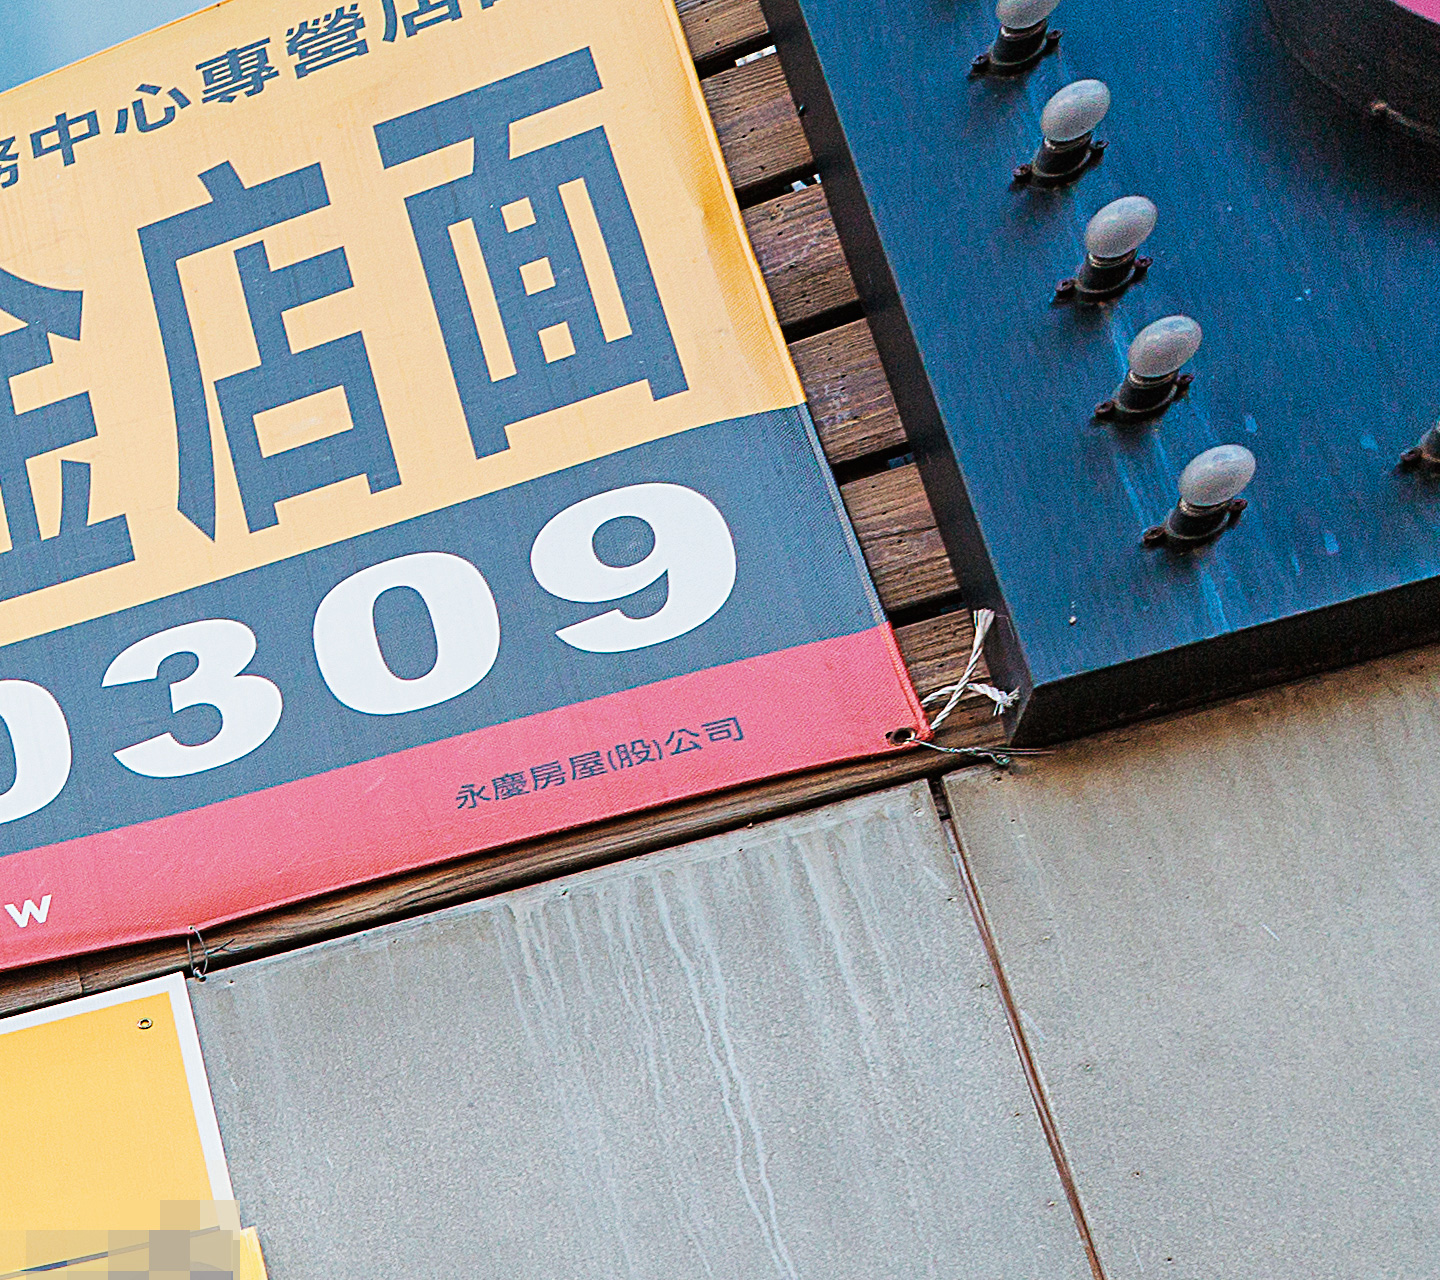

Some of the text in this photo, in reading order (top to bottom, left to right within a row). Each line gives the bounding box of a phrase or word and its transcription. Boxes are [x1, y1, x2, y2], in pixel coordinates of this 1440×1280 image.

[455, 715, 746, 813] 永慶房屋(股)公司
